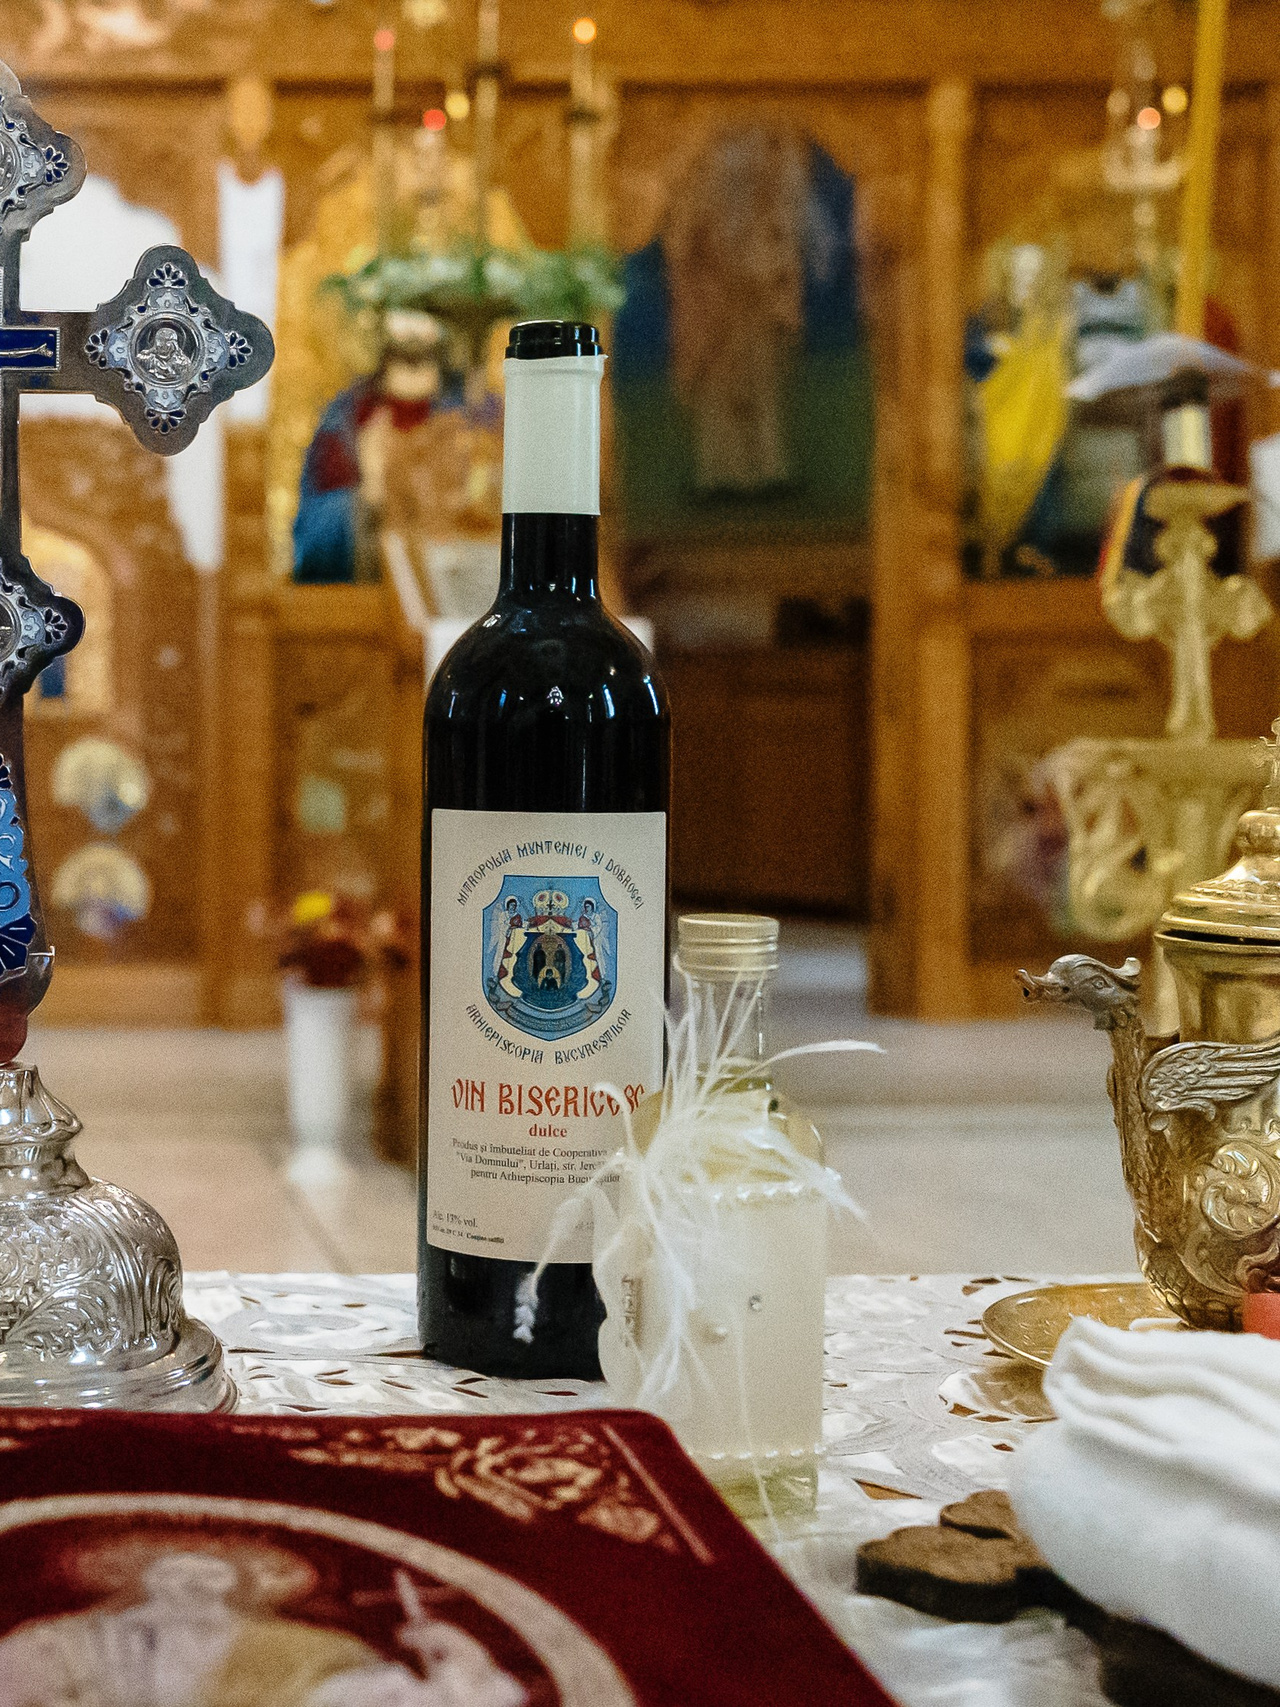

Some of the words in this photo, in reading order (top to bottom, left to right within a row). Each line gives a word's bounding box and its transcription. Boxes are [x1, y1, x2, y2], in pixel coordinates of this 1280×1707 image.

[604, 857, 645, 910] DOBROGEI
[466, 1003, 544, 1064] ARHIEPISCOPIA
[451, 1078, 485, 1112] VIN
[528, 1122, 568, 1138] dulce
[452, 1137, 479, 1151] Produs
[538, 1146, 551, 1157] de
[470, 1168, 499, 1180] pentru
[500, 1171, 566, 1186] Arhiepiscopia
[463, 1217, 479, 1229] vol.
